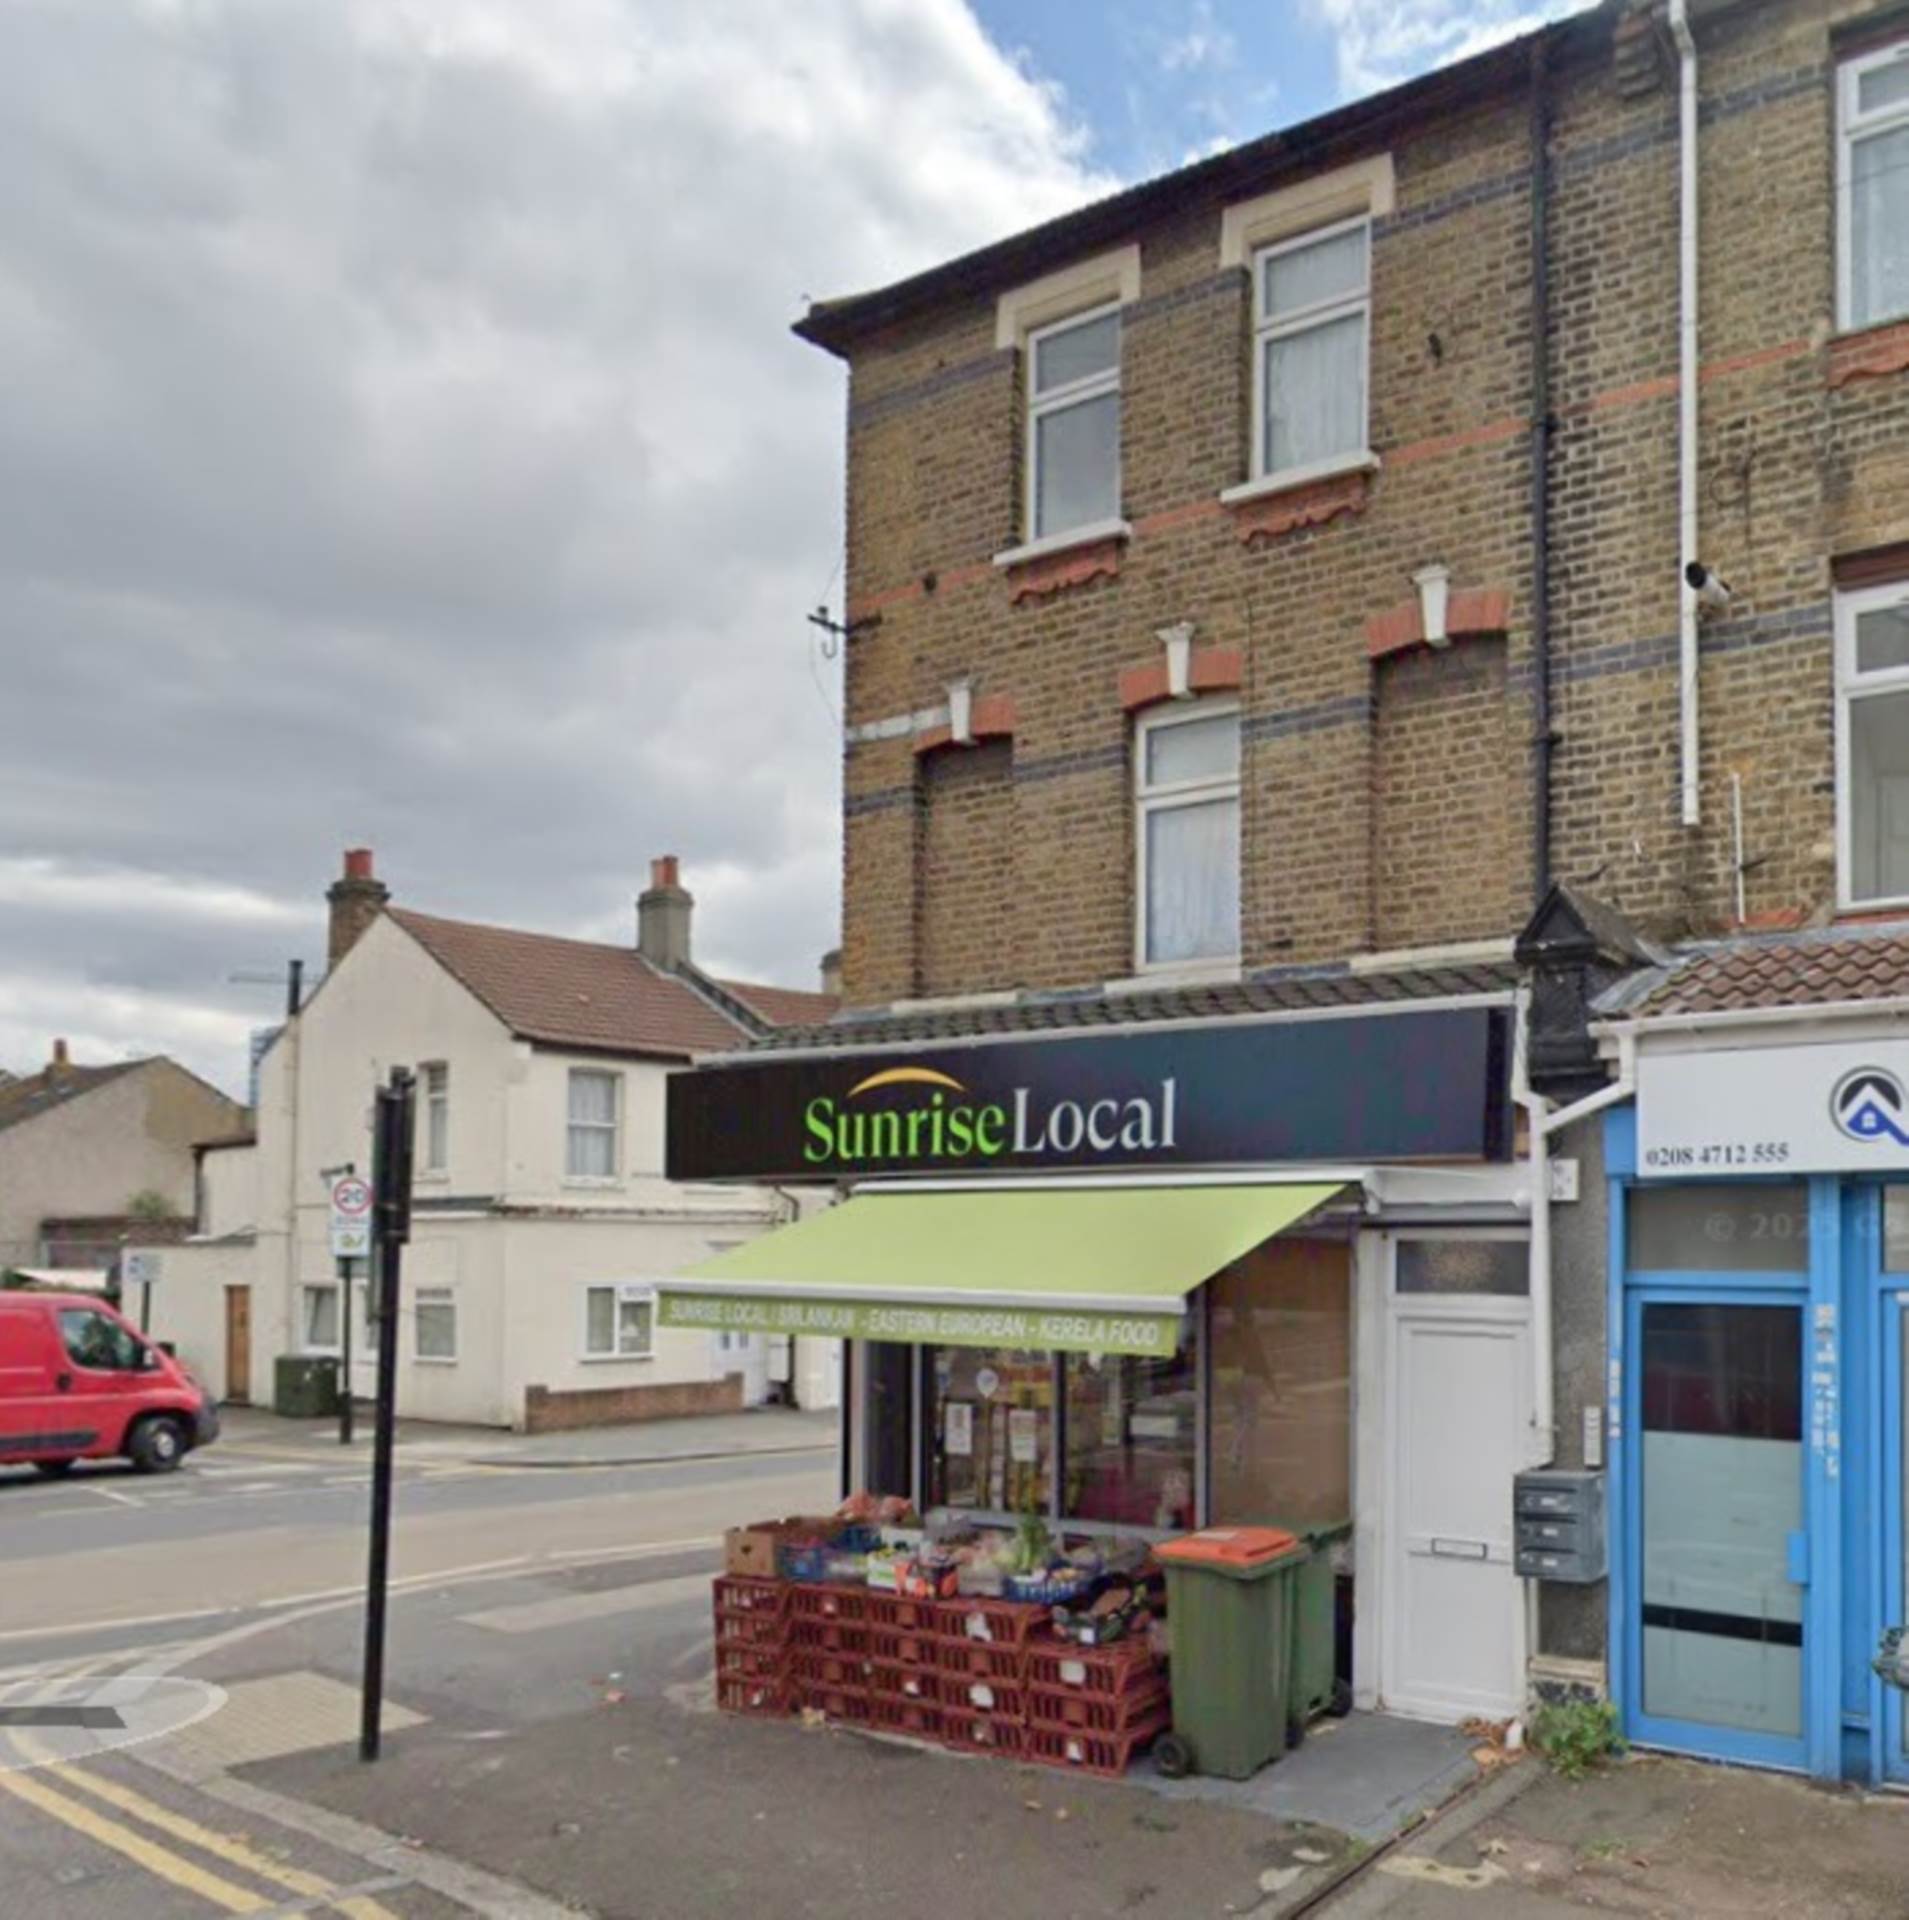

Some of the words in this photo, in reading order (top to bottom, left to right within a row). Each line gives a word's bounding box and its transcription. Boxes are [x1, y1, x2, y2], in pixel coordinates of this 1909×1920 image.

[1646, 1147, 1694, 1167] 0208
[1699, 1145, 1747, 1165] 4712
[1752, 1143, 1790, 1163] 555
[869, 1308, 937, 1334] EASTERN
[940, 1312, 1026, 1338] EUROPEAN
[1040, 1317, 1105, 1342] KERELA
[1109, 1321, 1159, 1346] FOOD
